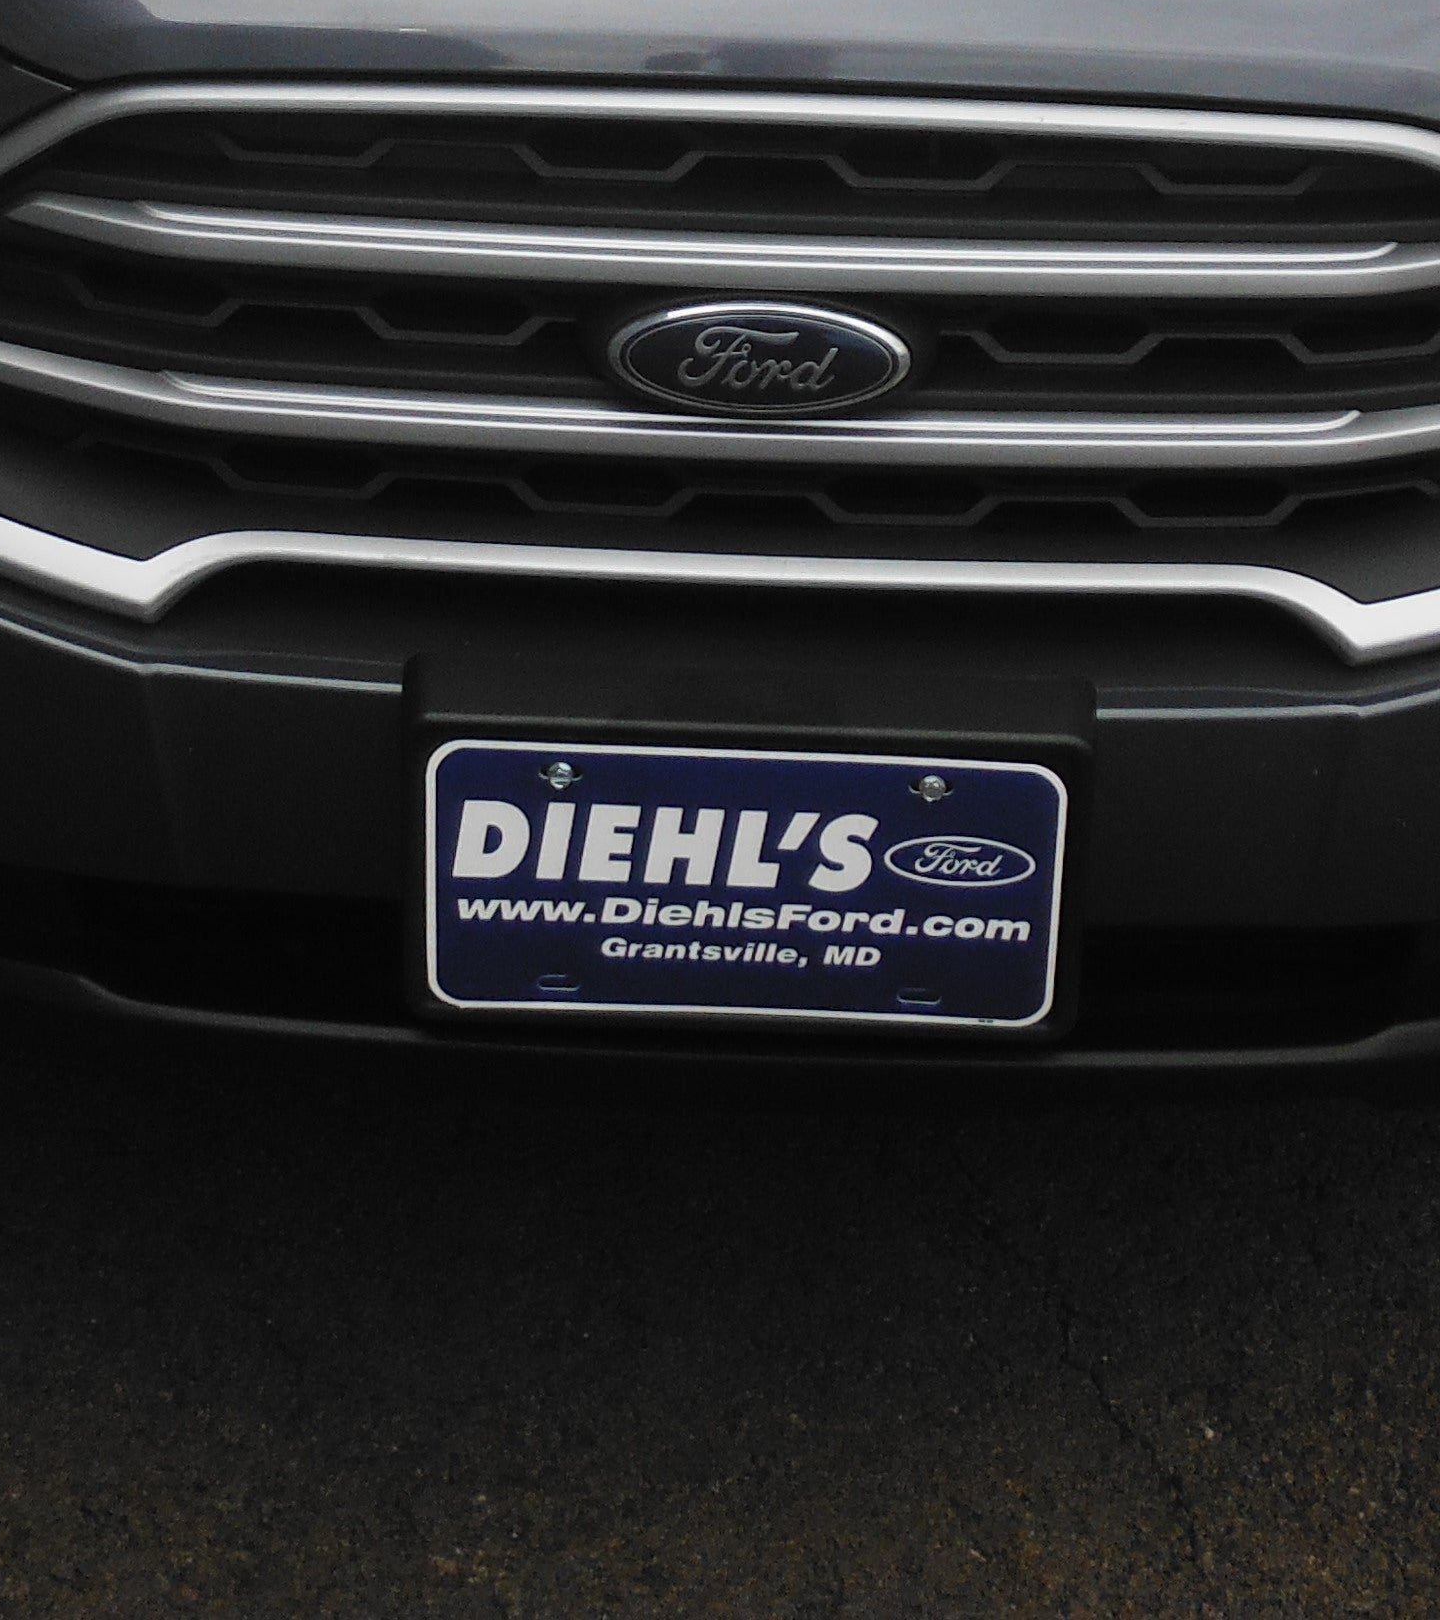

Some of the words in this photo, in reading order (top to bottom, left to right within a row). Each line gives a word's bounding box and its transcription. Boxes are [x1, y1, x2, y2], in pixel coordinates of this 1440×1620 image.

[677, 325, 839, 390] Ford
[451, 799, 879, 893] DIEHL'S
[914, 842, 1003, 878] Ford
[457, 896, 1031, 943] www.DiehlsFord.com
[600, 937, 808, 968] Grantsville,
[822, 945, 882, 967] MD
